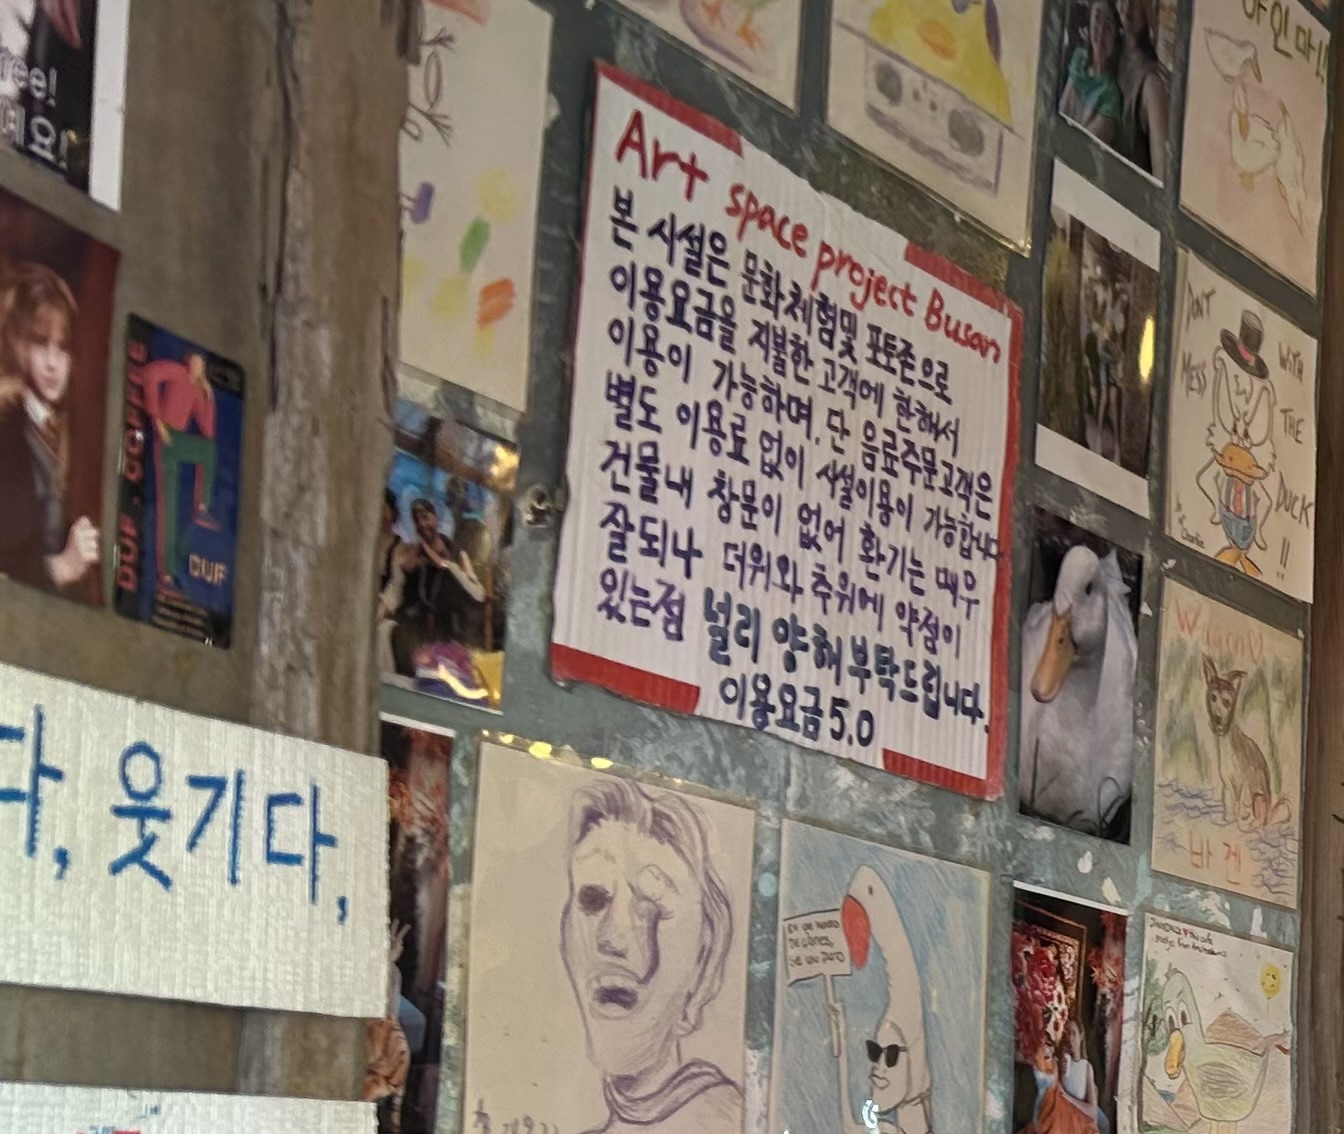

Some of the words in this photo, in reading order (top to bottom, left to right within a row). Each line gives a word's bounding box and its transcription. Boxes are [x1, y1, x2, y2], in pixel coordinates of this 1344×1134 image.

[609, 185, 640, 253] 본
[647, 212, 732, 290] 시설은
[740, 248, 860, 366] 문화체험및
[615, 109, 709, 202] Art
[724, 182, 810, 258] space
[809, 240, 918, 318] project
[924, 287, 1001, 365] Busan
[604, 369, 664, 434] 별도
[675, 396, 750, 466] 이용료
[758, 429, 807, 491] 없이
[607, 316, 693, 384] 이용이
[609, 262, 738, 354] 이용요금을
[747, 318, 816, 387] 지불한
[892, 389, 961, 457] 한해서
[187, 553, 229, 585] DUF
[599, 500, 704, 581] 잘되나
[722, 540, 804, 604] 더위와
[810, 563, 886, 633] 추위에
[895, 601, 963, 660] 약점이
[600, 440, 696, 509] 건물내
[706, 471, 784, 534] 창문이
[798, 503, 845, 565] 없어
[857, 523, 928, 596] 환기는
[935, 566, 981, 621] 매우
[702, 586, 762, 667] 널리
[108, 739, 349, 926] 웃기다,
